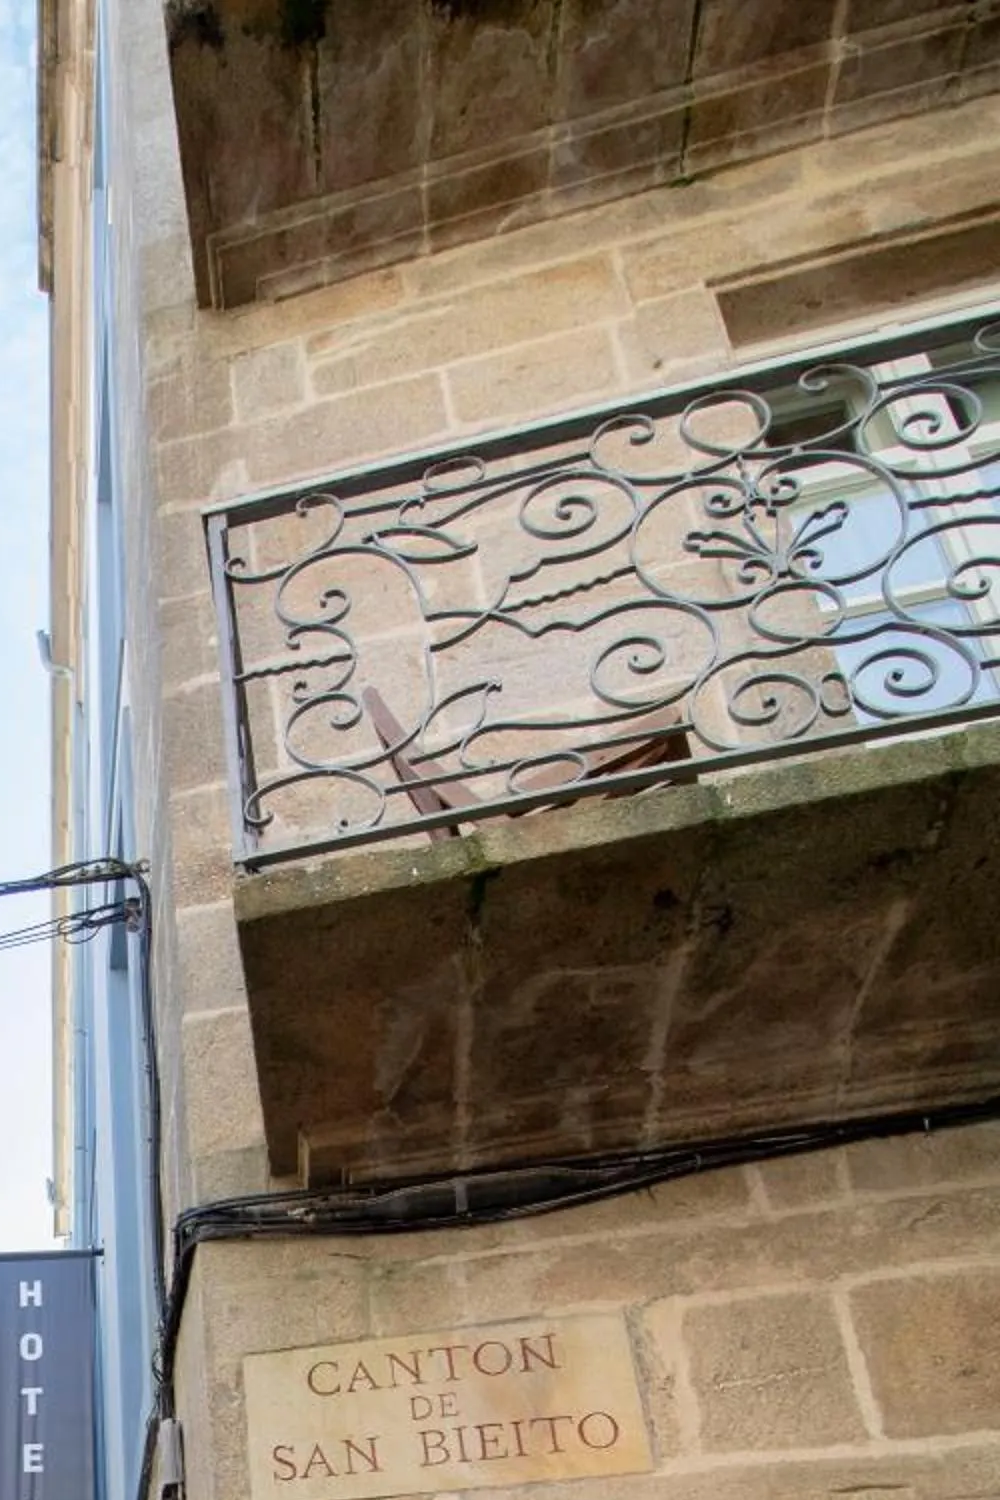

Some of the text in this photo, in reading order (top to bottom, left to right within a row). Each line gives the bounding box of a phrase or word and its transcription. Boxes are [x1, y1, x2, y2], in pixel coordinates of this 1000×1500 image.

[306, 1333, 561, 1397] CANTON
[409, 1392, 459, 1421] DE
[272, 1411, 619, 1482] SAN BIEITO
